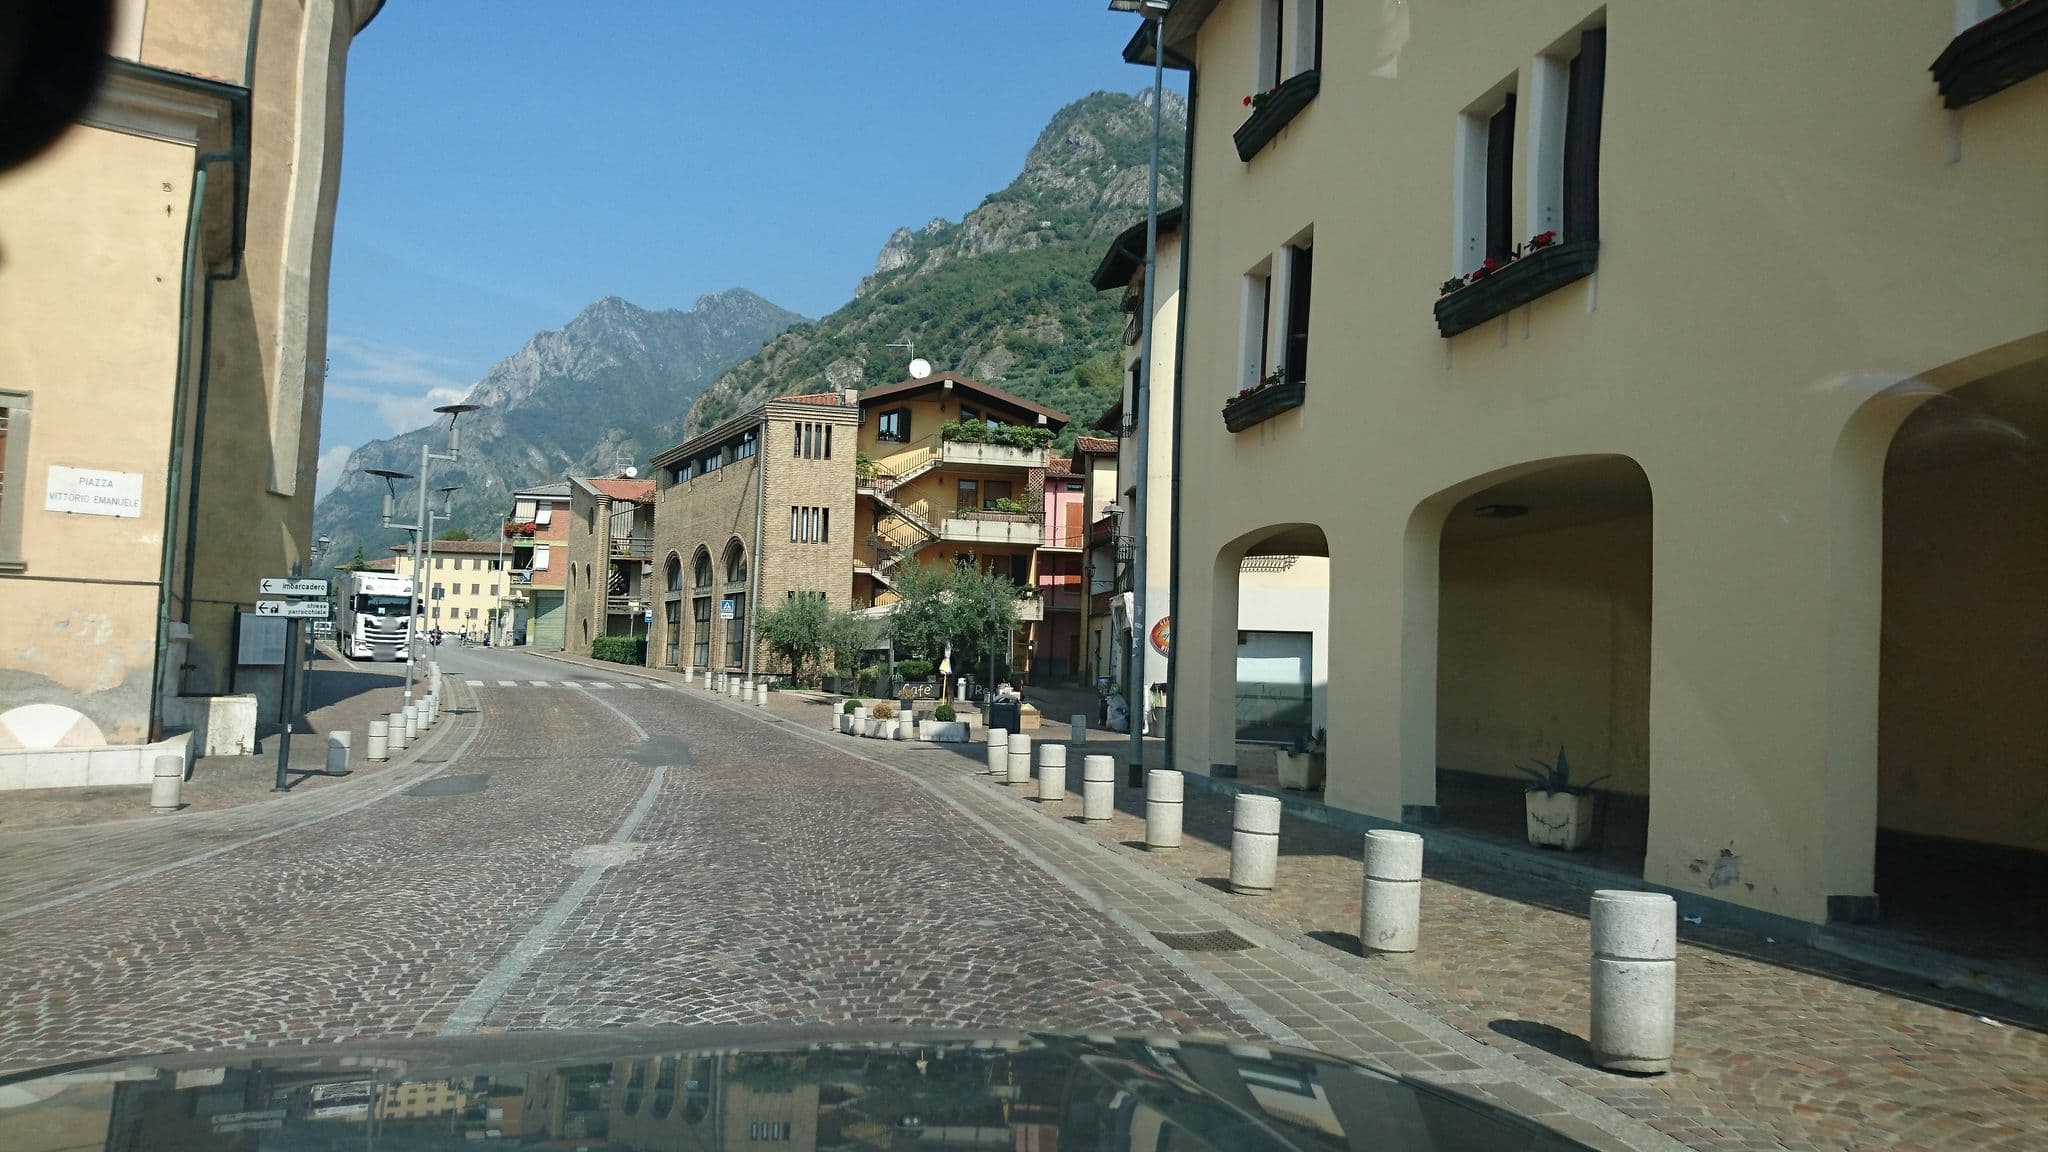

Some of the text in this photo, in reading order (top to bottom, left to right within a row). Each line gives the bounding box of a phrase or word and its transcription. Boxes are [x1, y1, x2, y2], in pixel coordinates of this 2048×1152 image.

[79, 476, 113, 488] PIAZZA
[49, 491, 140, 508] VITTORIO EMANUELE
[282, 582, 326, 591] imbarcadero
